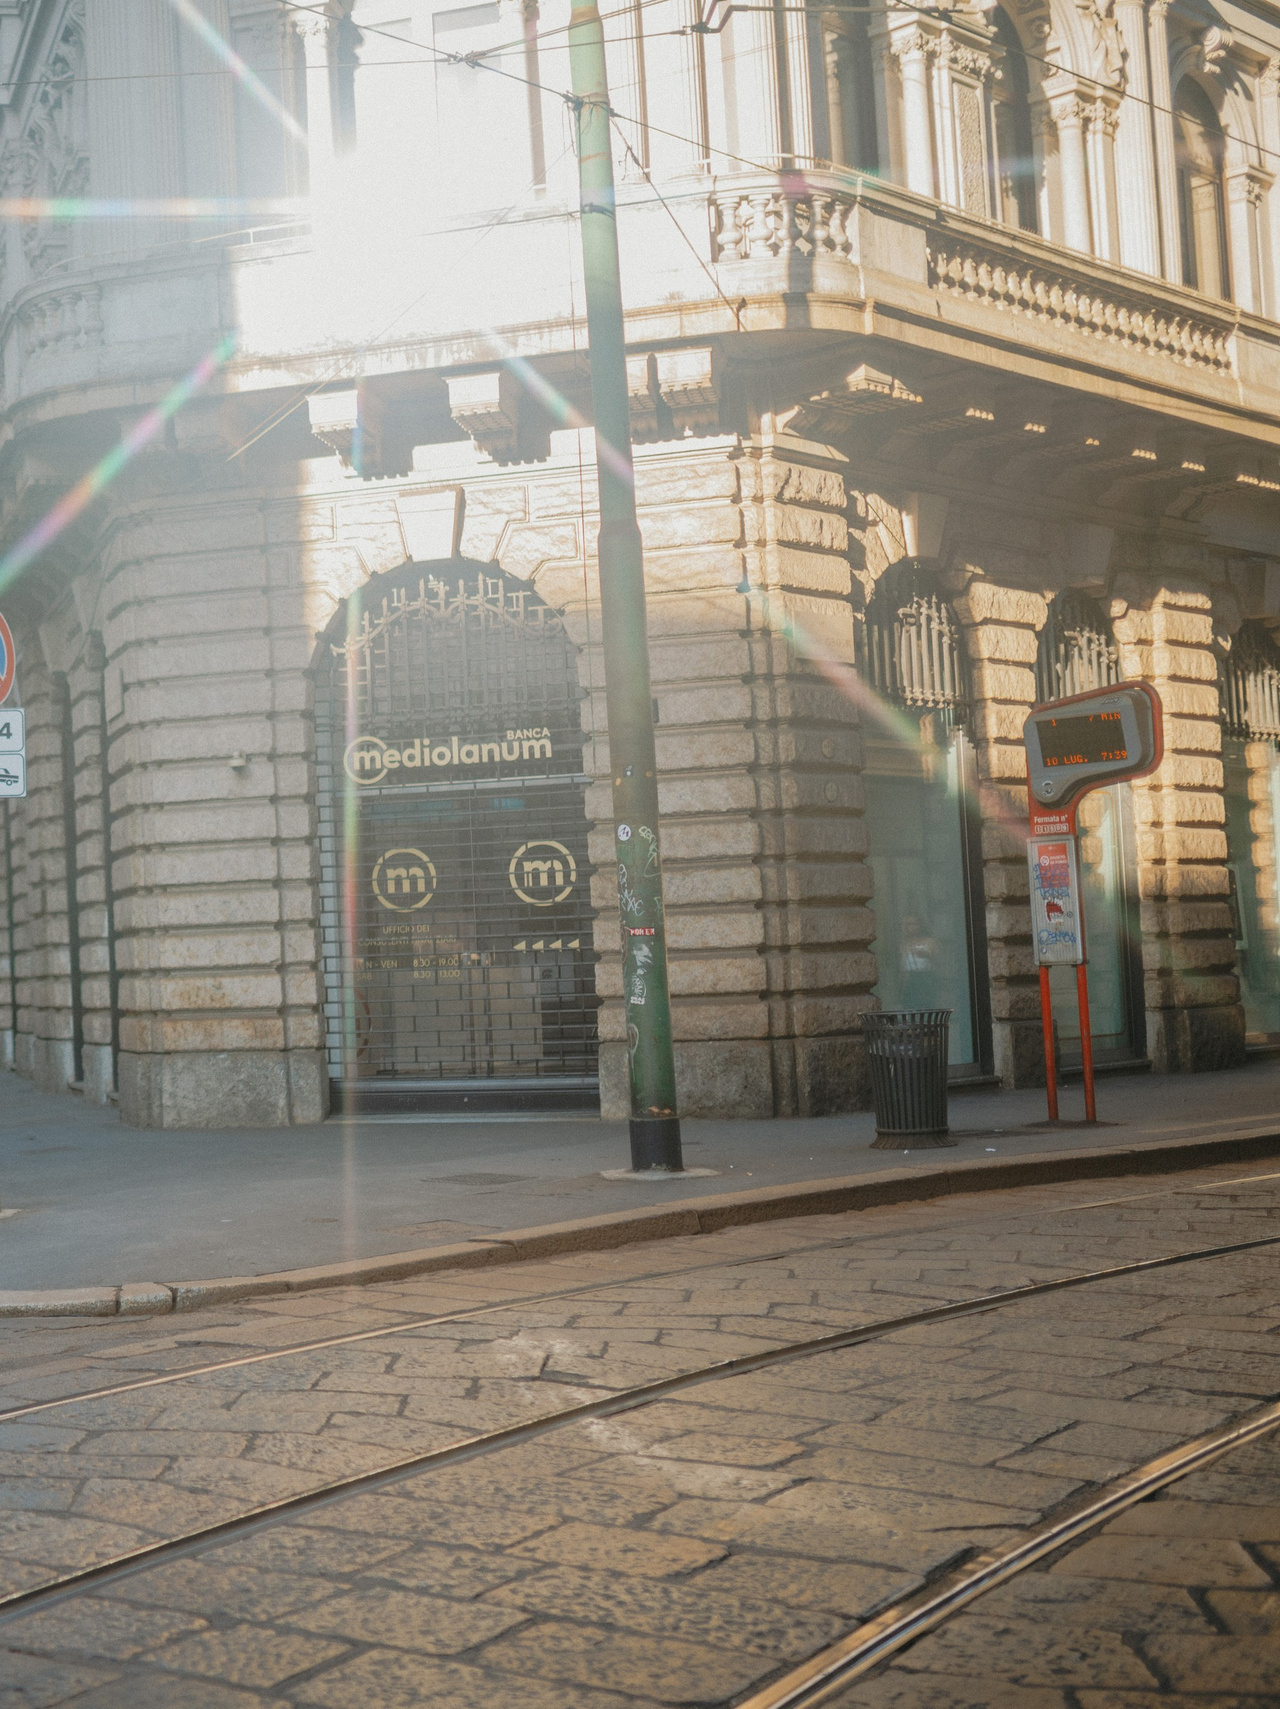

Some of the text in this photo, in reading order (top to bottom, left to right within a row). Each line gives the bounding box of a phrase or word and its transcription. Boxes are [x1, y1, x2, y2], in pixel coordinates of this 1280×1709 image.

[1101, 712, 1121, 721] MIN
[506, 727, 551, 741] BANCA
[350, 736, 553, 772] mediolanum
[1046, 750, 1127, 766] 10 LUG. 7:39
[1034, 815, 1059, 824] Fermata
[382, 924, 430, 934] UFFICIO DEI
[381, 960, 398, 969] VEN
[413, 958, 430, 967] 8.30
[438, 957, 458, 966] 19.00
[413, 970, 431, 979] 8.30
[439, 969, 460, 978] 13.00
